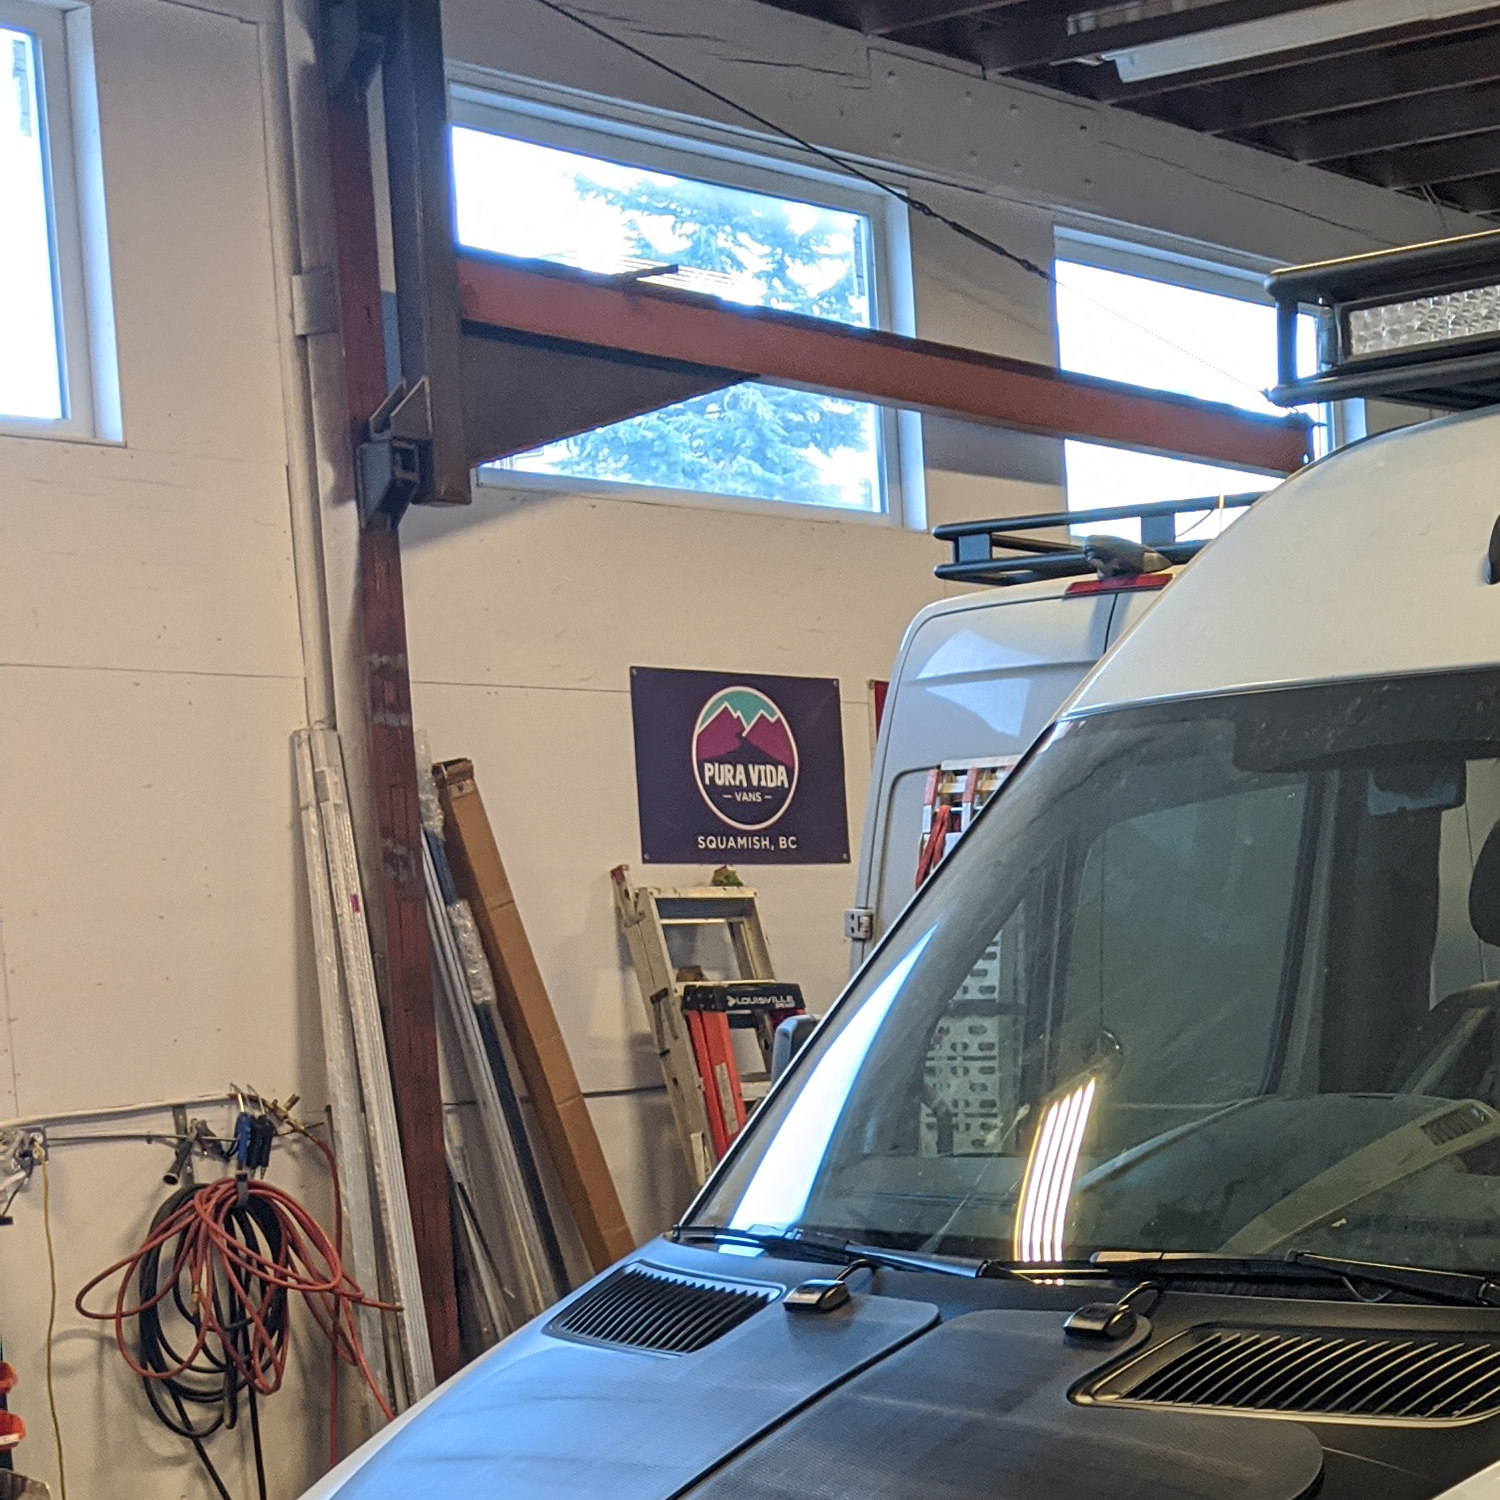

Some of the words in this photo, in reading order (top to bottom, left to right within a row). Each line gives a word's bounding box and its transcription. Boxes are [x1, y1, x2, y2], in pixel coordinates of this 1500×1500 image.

[704, 762, 747, 788] PURA
[748, 763, 789, 789] VIDA
[735, 791, 762, 803] VANS
[697, 835, 775, 851] SQUAMISH,
[778, 836, 798, 849] BC
[736, 994, 794, 1006] LOUISVILLE
